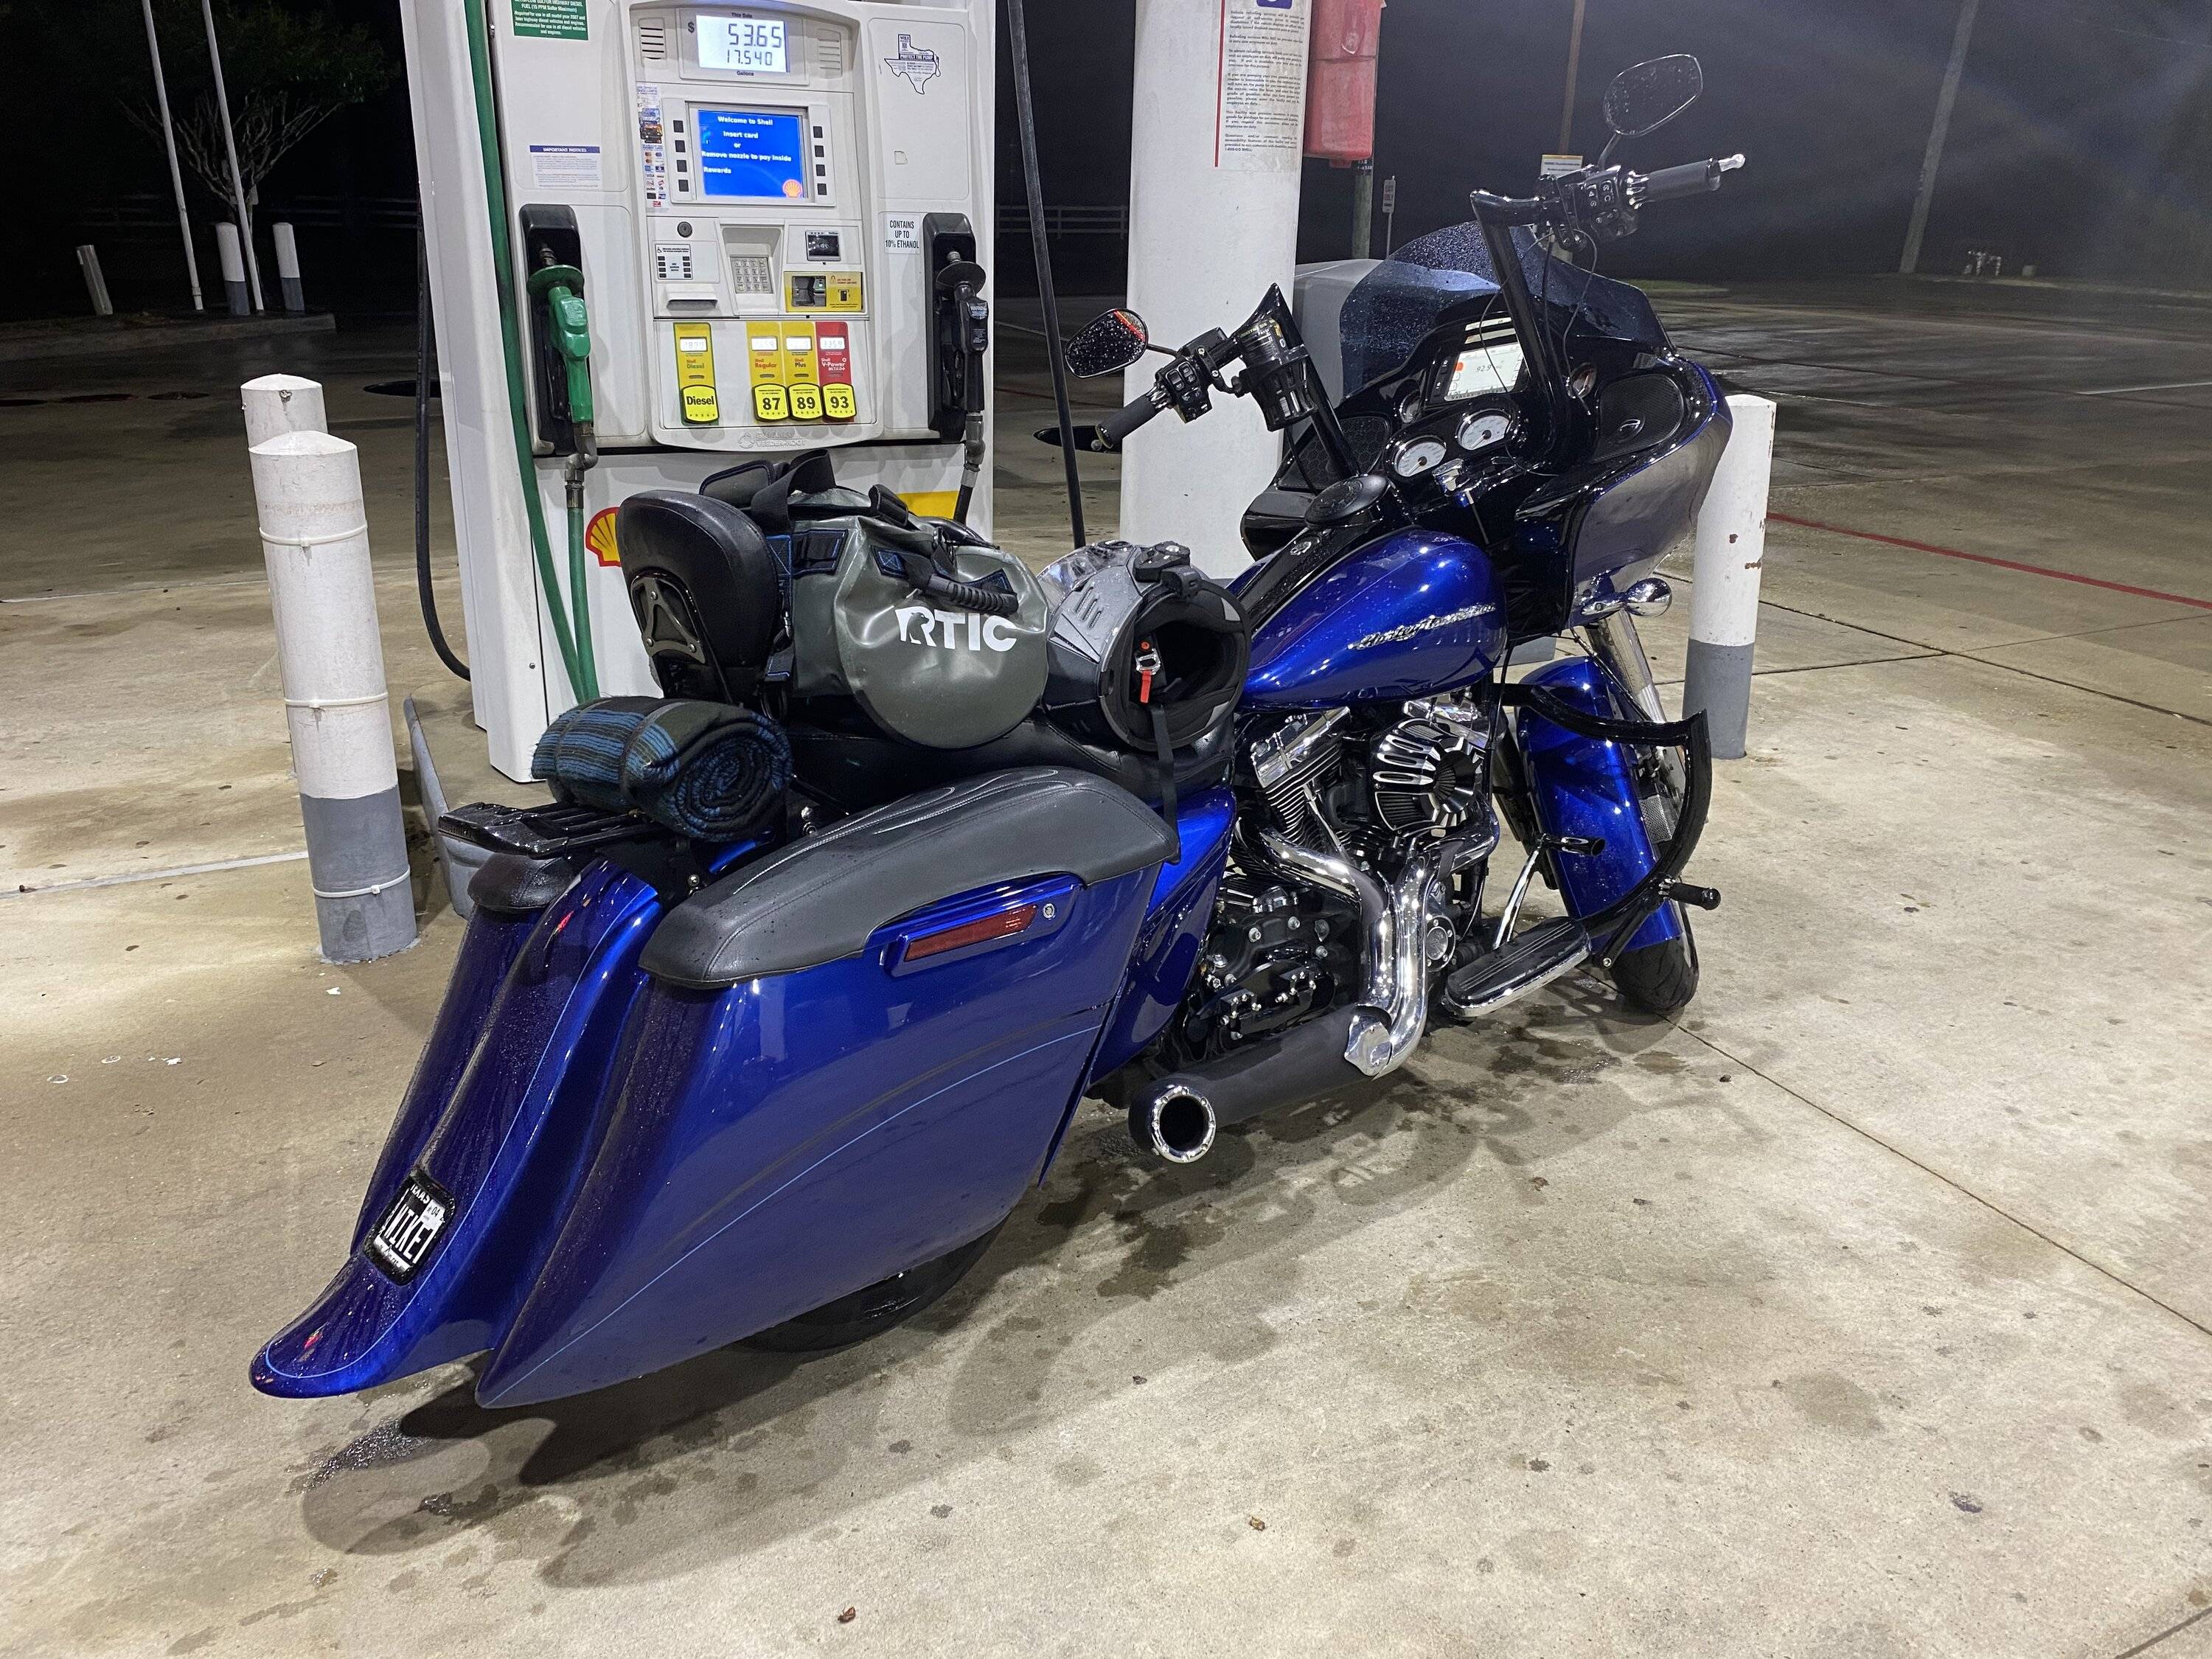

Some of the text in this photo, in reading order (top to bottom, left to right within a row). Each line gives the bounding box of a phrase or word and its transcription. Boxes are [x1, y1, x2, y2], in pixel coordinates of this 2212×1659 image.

[688, 21, 782, 48] $ 53.65
[727, 49, 773, 66] 17.540
[890, 220, 914, 229] CONTAINS
[885, 240, 919, 248] 10% ETHANOL
[686, 396, 714, 405] Diesel
[762, 397, 781, 410] 87
[797, 397, 815, 409] 89
[830, 396, 849, 408] 93
[894, 606, 1018, 652] RTIC
